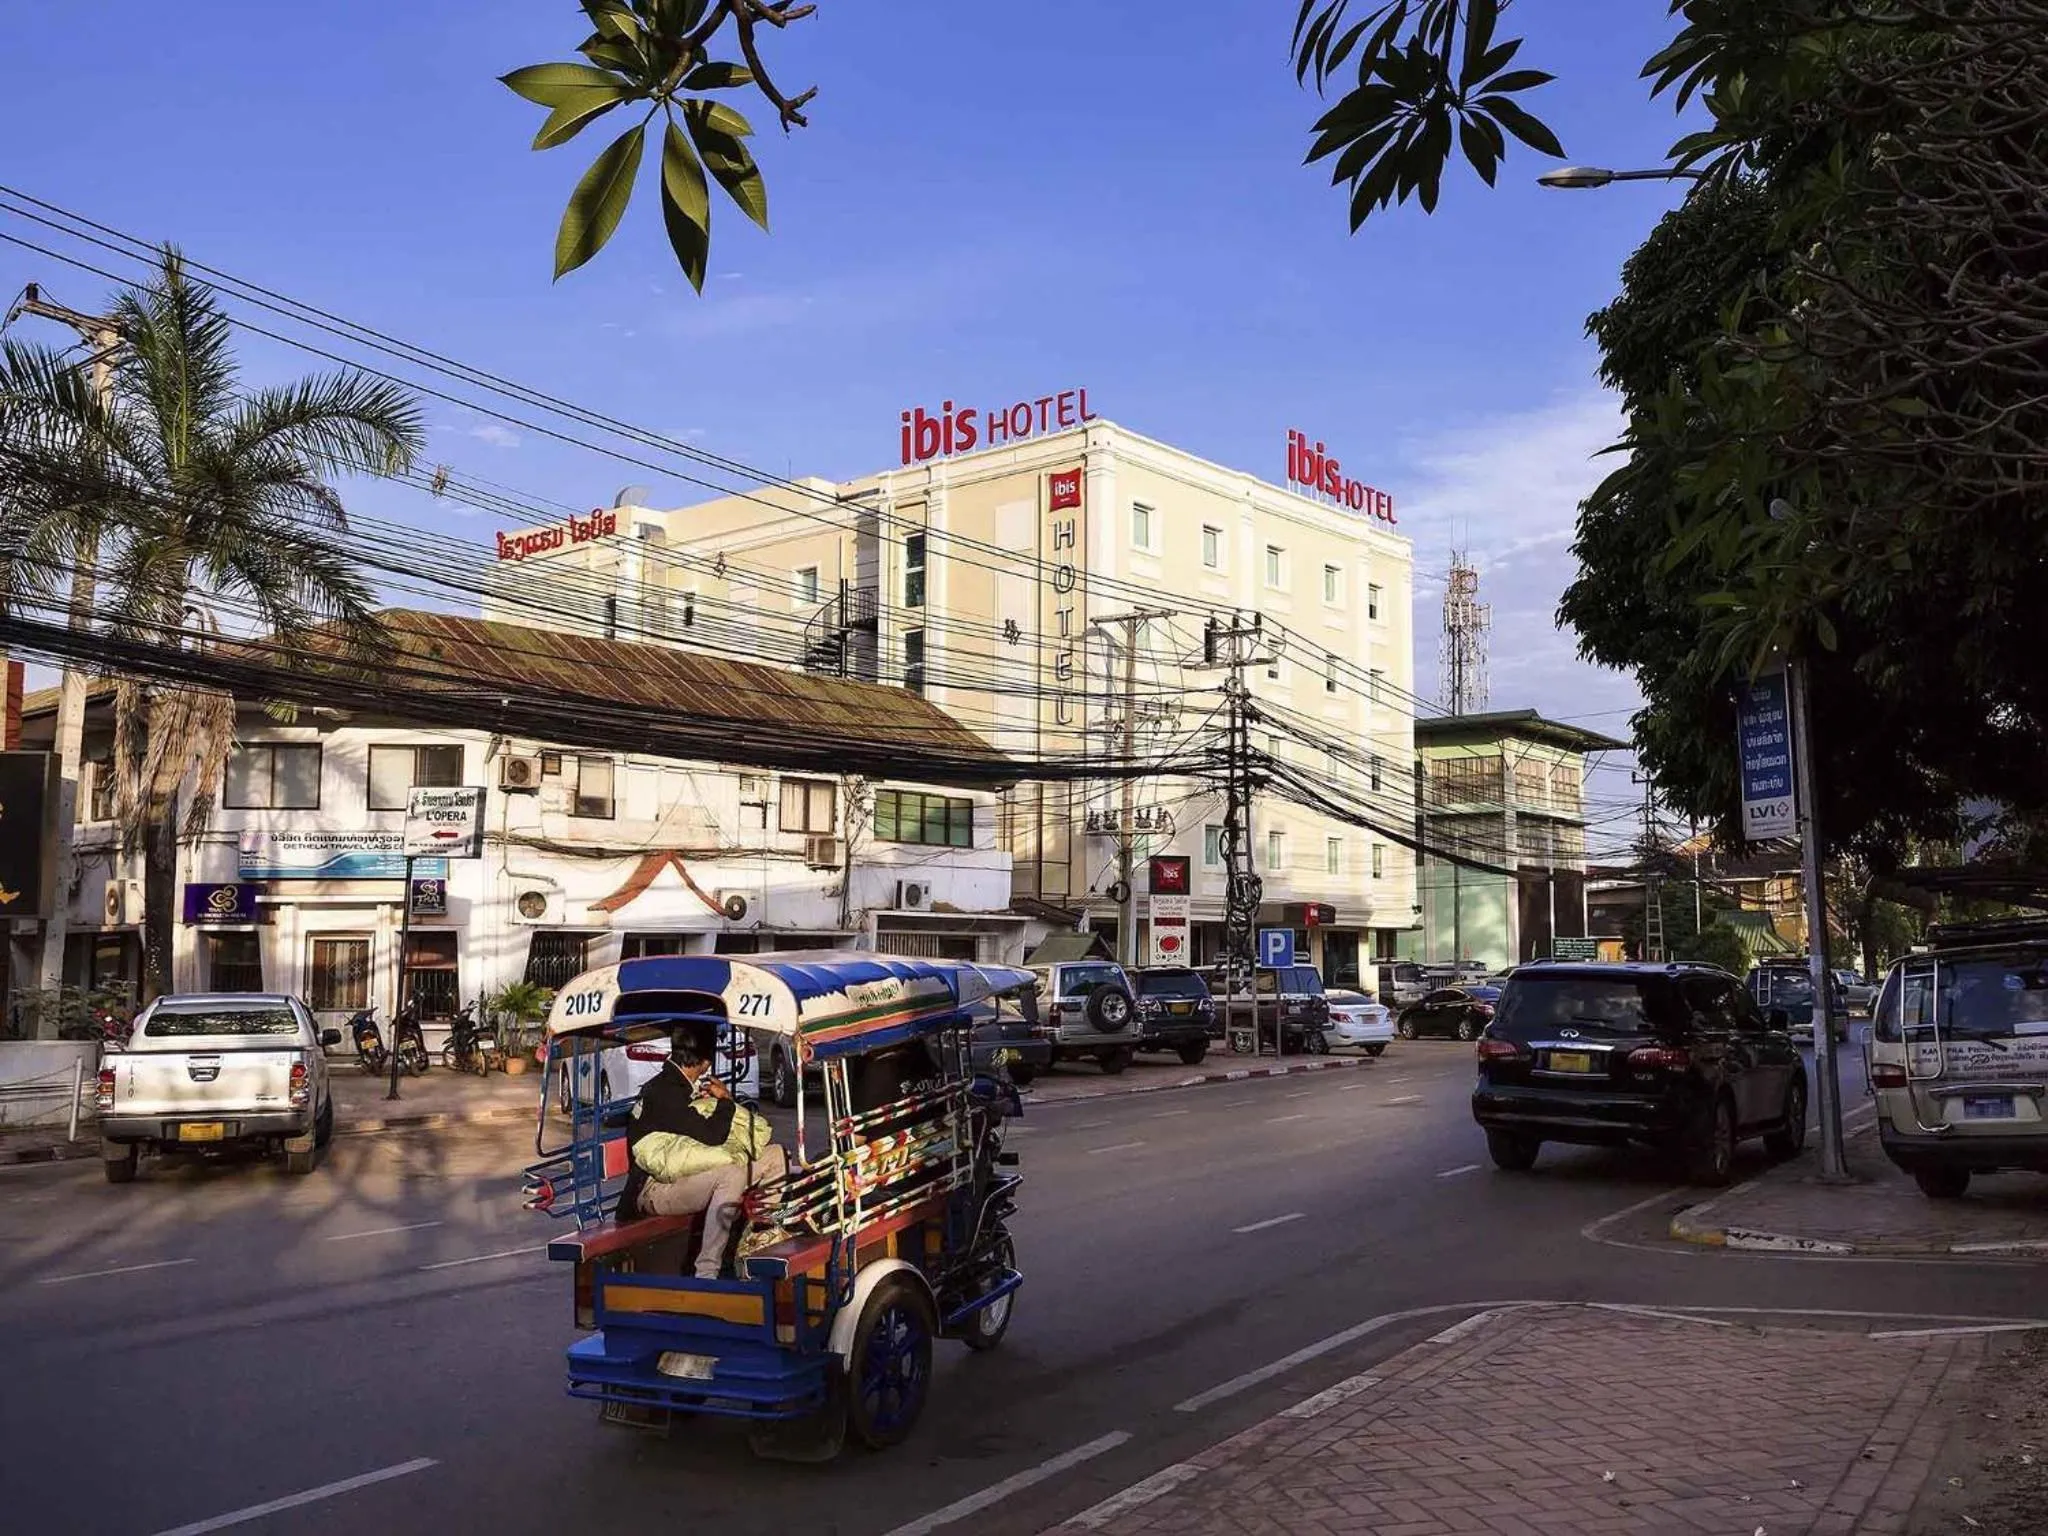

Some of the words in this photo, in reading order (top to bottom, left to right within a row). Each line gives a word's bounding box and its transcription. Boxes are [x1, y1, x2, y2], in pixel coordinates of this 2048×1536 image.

[901, 400, 977, 465] ibis
[988, 388, 1096, 444] HOTEL
[1054, 479, 1076, 496] ibis
[1288, 429, 1340, 497] ibis
[1336, 475, 1397, 525] HOTEL
[1054, 518, 1075, 725] HOTEL
[426, 811, 467, 821] L'OPERA
[1268, 932, 1286, 964] P
[565, 991, 603, 1015] 2013
[738, 994, 772, 1016] 271
